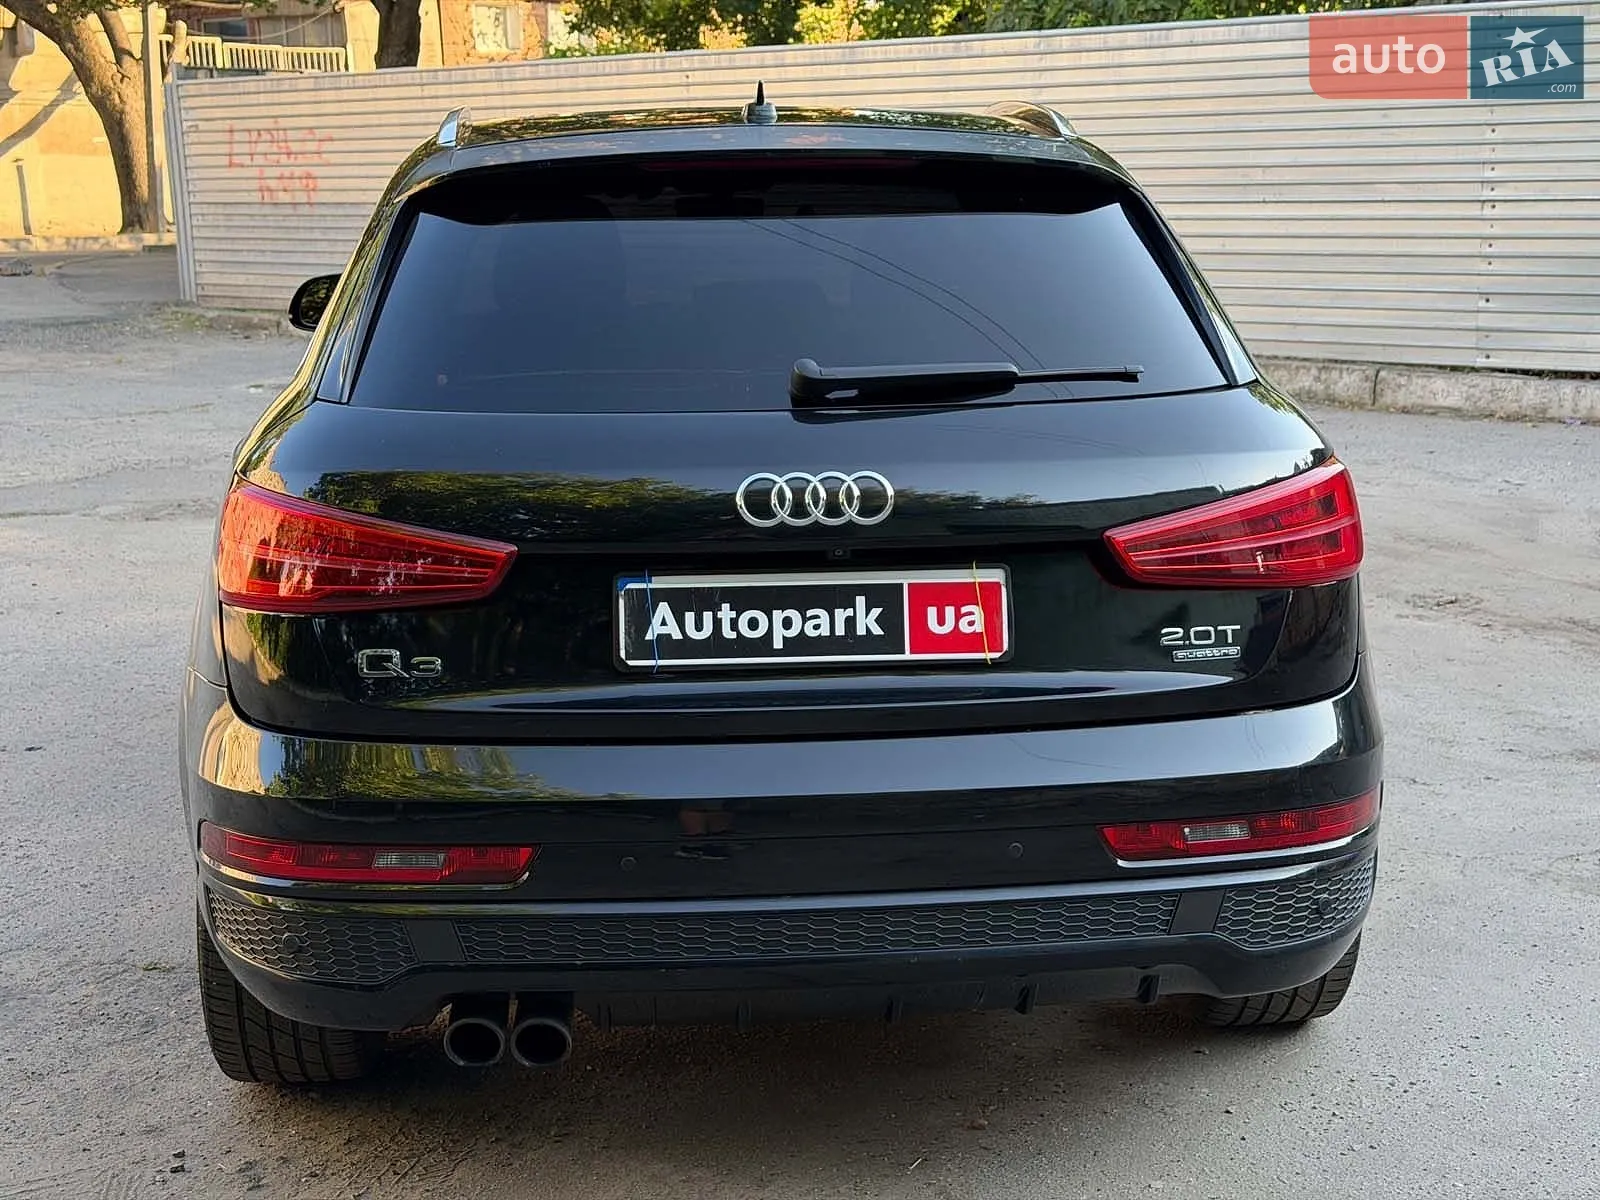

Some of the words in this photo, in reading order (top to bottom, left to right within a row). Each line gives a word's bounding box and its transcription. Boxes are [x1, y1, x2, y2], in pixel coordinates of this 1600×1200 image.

[644, 595, 885, 649] Autopark
[927, 604, 984, 635] ua
[1160, 625, 1241, 646] 2.0T
[358, 648, 441, 678] Q3
[1175, 648, 1239, 660] quattro
